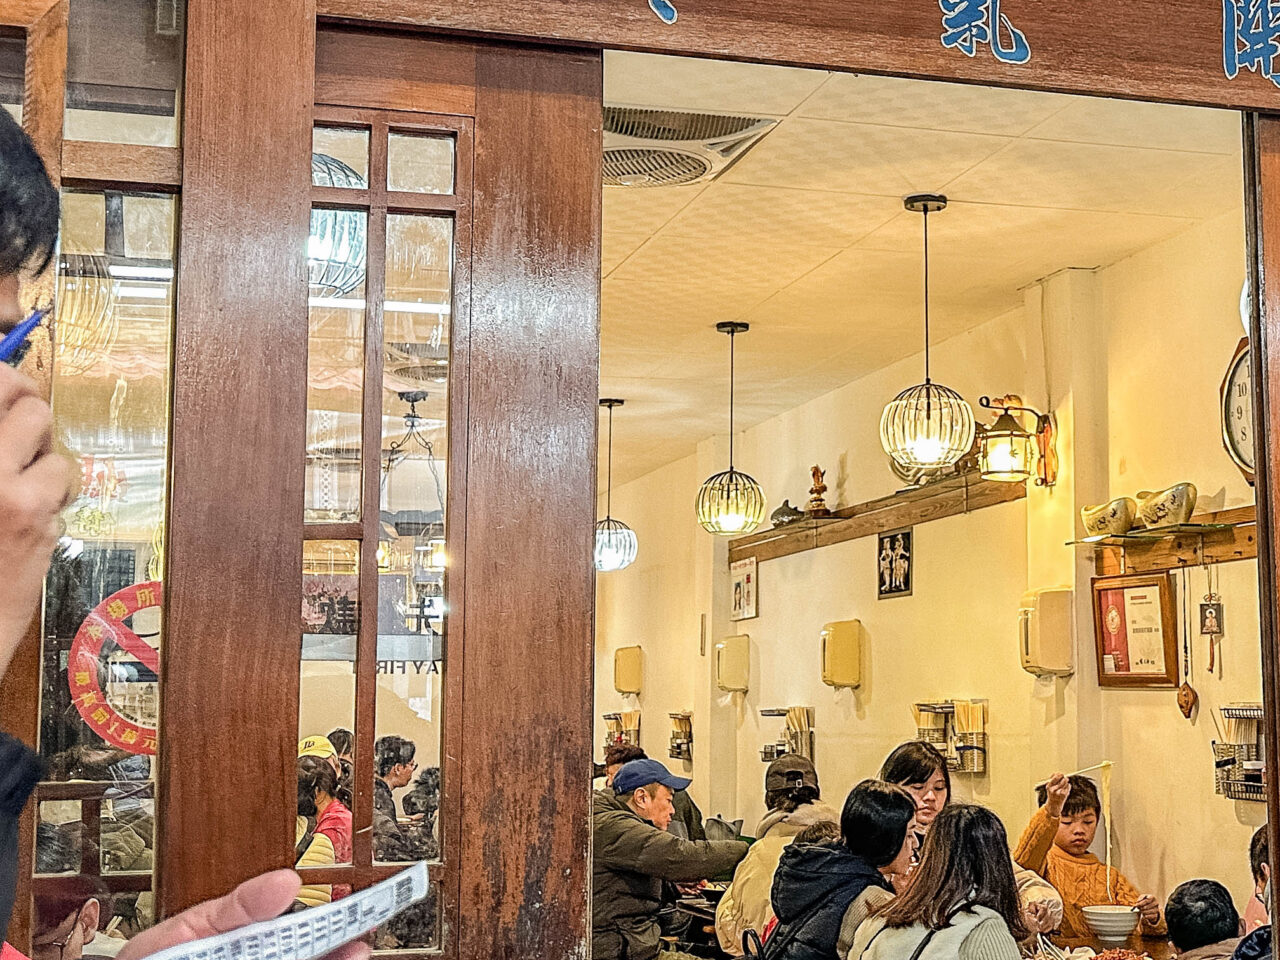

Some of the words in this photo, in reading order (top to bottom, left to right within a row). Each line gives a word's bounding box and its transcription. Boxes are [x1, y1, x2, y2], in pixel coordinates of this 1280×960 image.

[1237, 381, 1247, 398] 10
[1236, 405, 1243, 420] 9
[1240, 426, 1248, 442] 8
